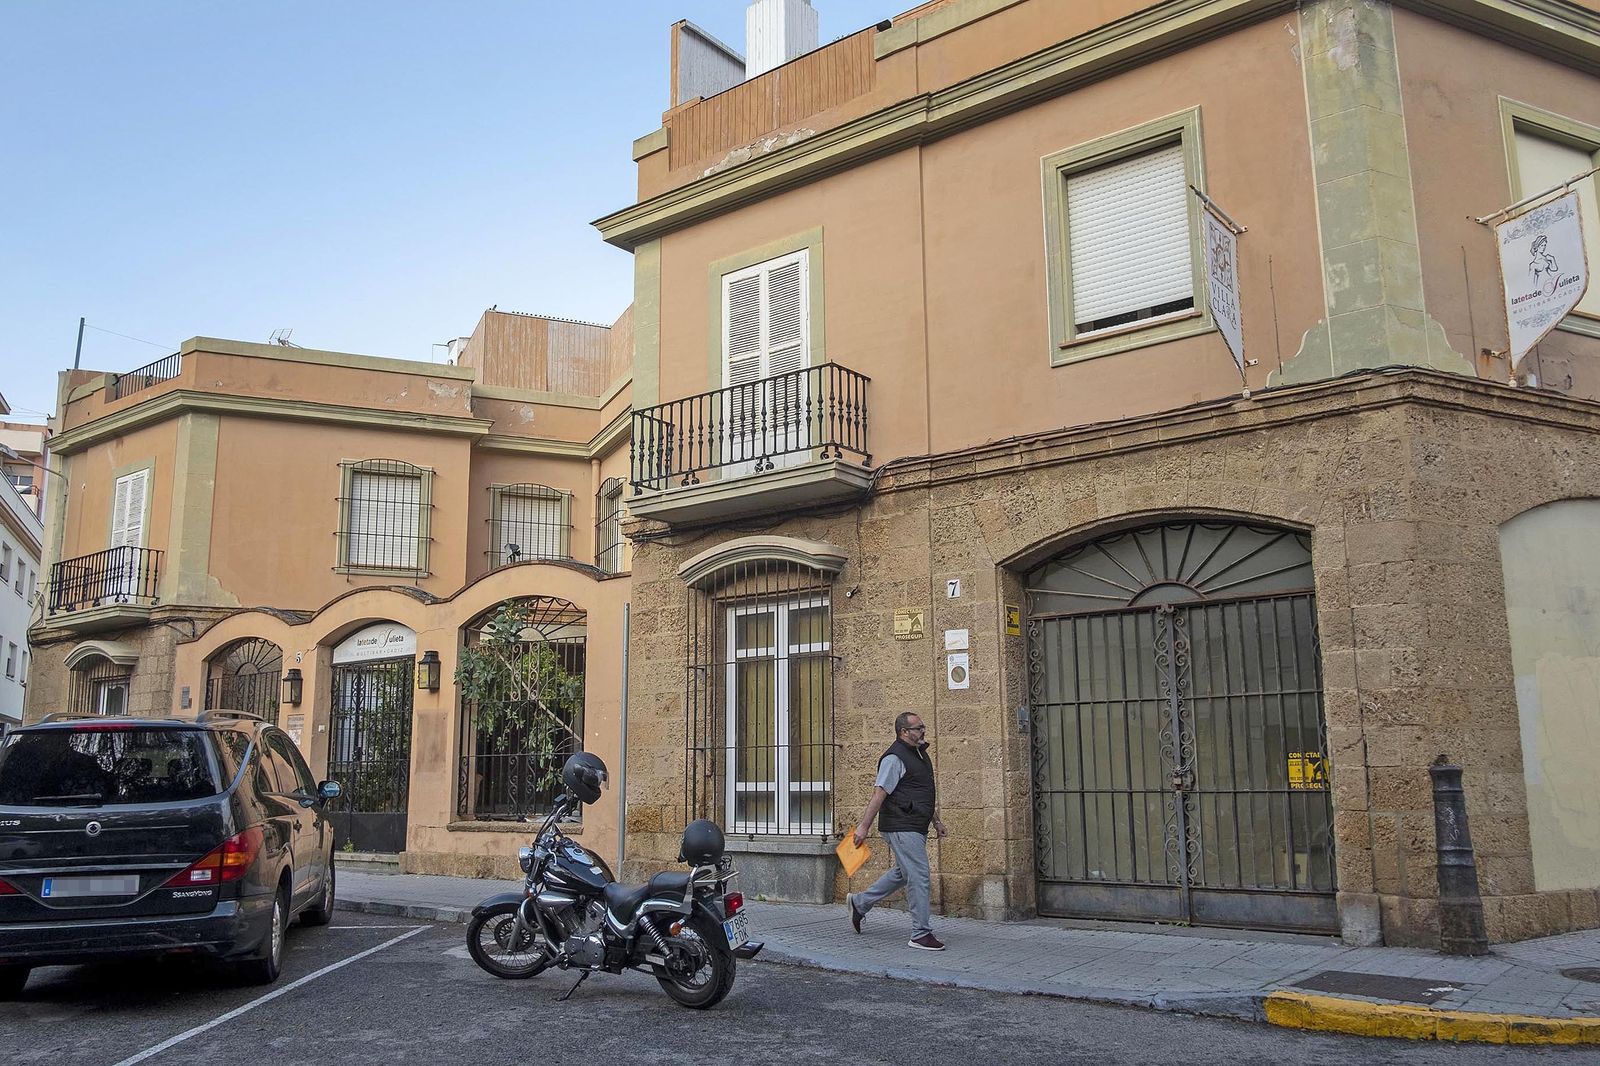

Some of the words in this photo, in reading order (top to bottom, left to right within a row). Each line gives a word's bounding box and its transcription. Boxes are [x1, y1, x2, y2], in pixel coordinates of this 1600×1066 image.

[1211, 281, 1235, 311] VILLA
[1213, 296, 1237, 330] CLARA
[948, 580, 959, 597] 7
[729, 912, 749, 932] 7885
[734, 927, 749, 944] FDK
